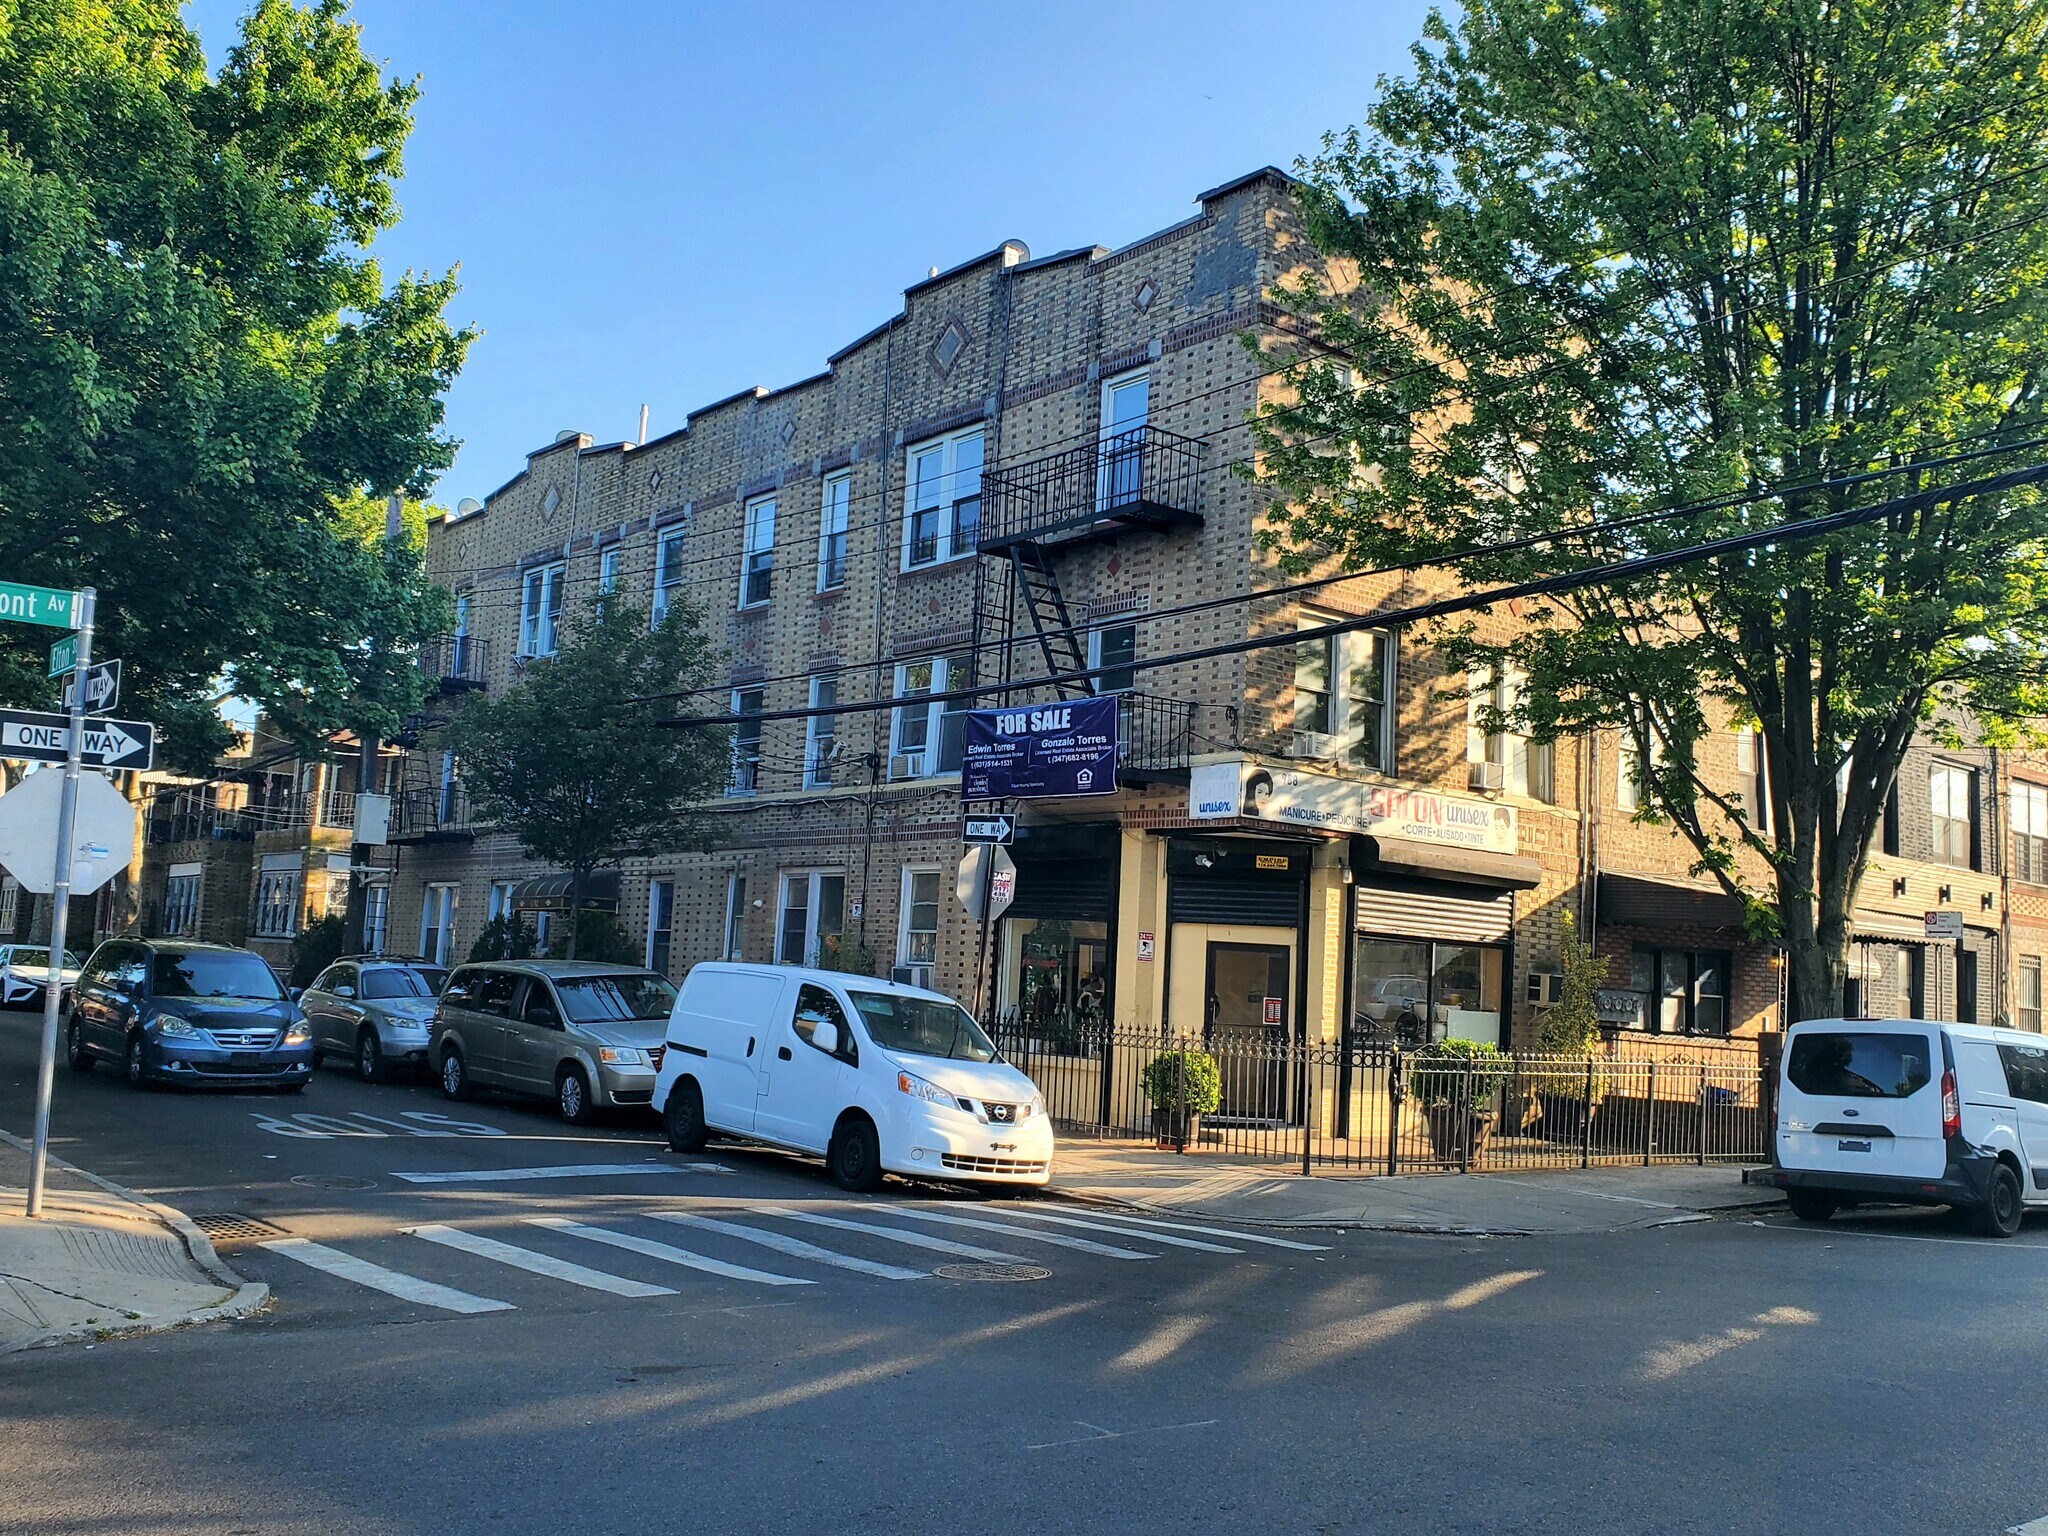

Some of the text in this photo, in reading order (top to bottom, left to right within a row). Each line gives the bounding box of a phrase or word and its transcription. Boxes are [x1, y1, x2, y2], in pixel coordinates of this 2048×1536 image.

[48, 595, 66, 612] Av
[51, 646, 70, 672] Elton
[93, 677, 110, 698] WAY
[996, 708, 1071, 735] FOR SALE
[19, 727, 128, 753] ONE WAY
[968, 743, 1016, 754] Edwin Torres
[1041, 735, 1107, 748] Gonzalo Torres
[1281, 773, 1298, 787] 988
[1199, 801, 1232, 813] unisex
[1370, 788, 1490, 827] SALON unisex
[970, 823, 1006, 834] ONE WAY
[1405, 825, 1484, 845] CORTE ALISADO TINTE
[248, 1111, 508, 1139] STOP
